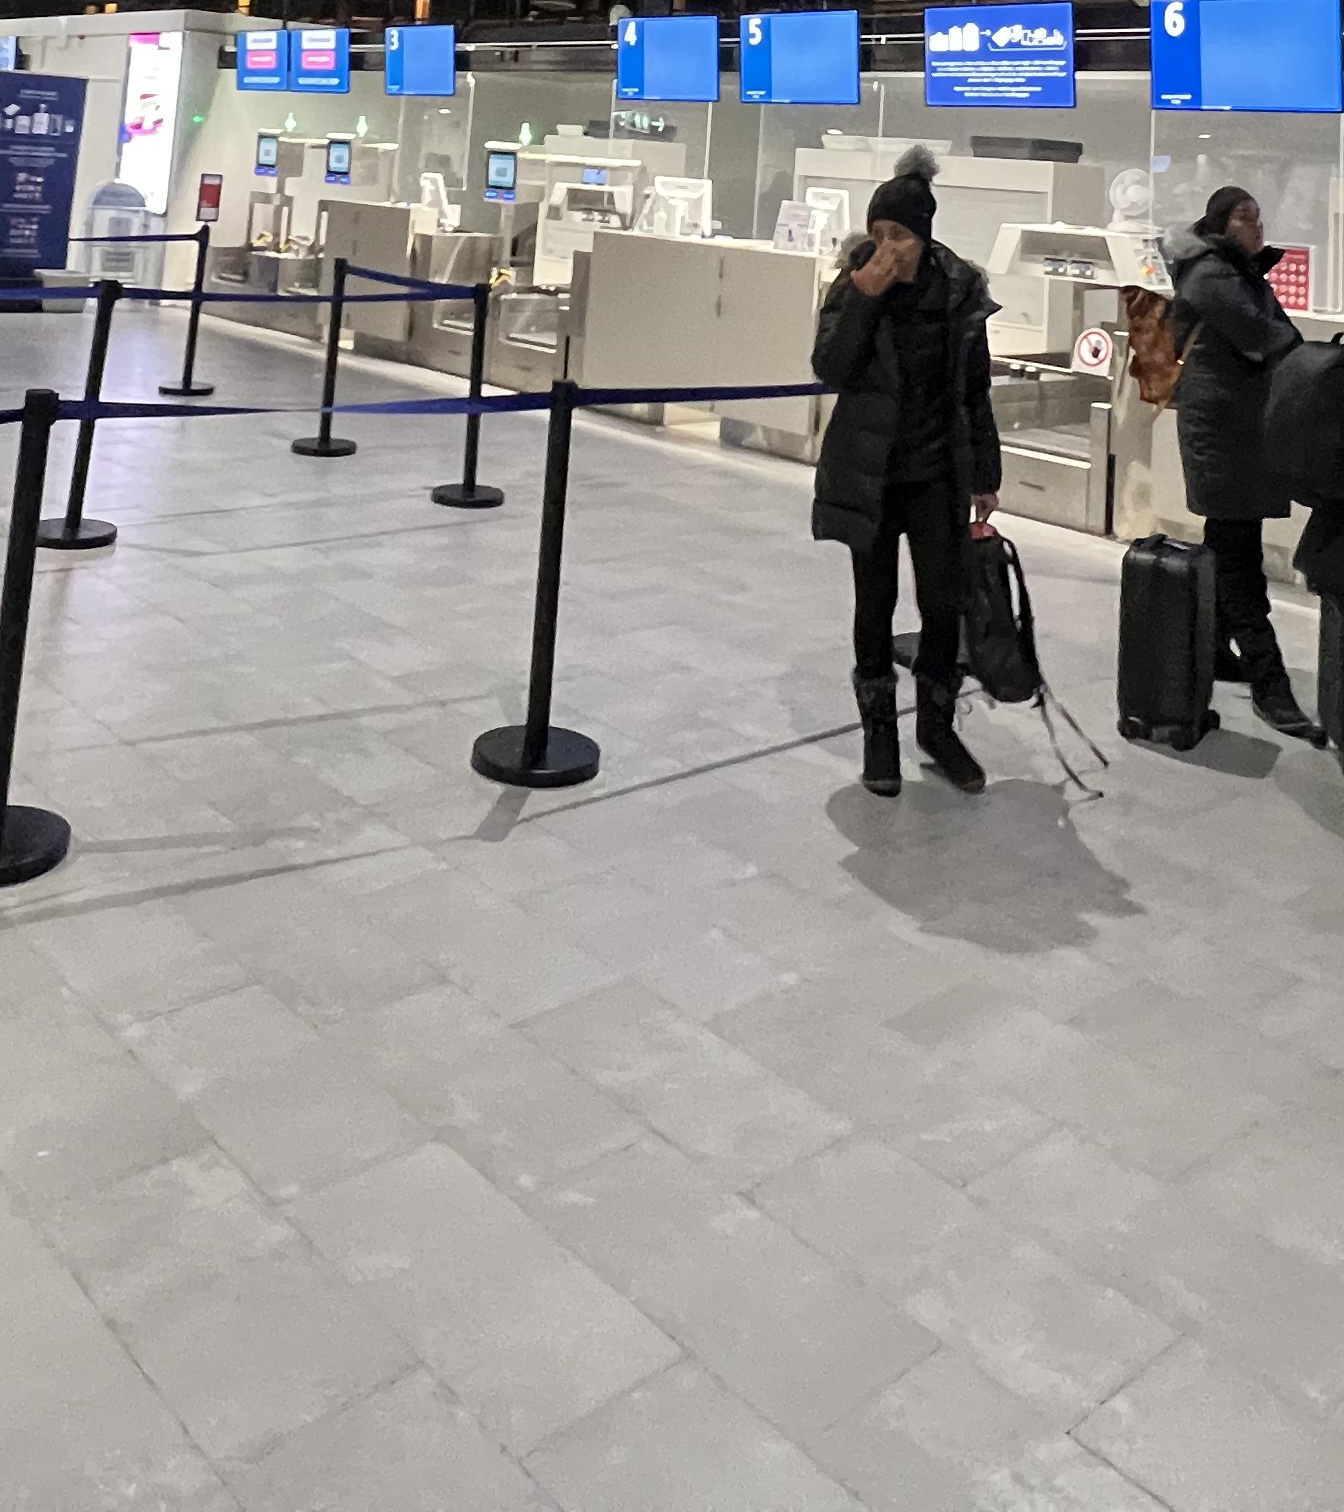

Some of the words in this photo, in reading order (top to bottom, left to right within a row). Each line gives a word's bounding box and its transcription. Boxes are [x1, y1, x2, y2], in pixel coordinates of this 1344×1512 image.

[748, 18, 763, 46] 5
[1164, 1, 1186, 37] 6
[389, 29, 400, 51] 3
[624, 21, 638, 46] 4
